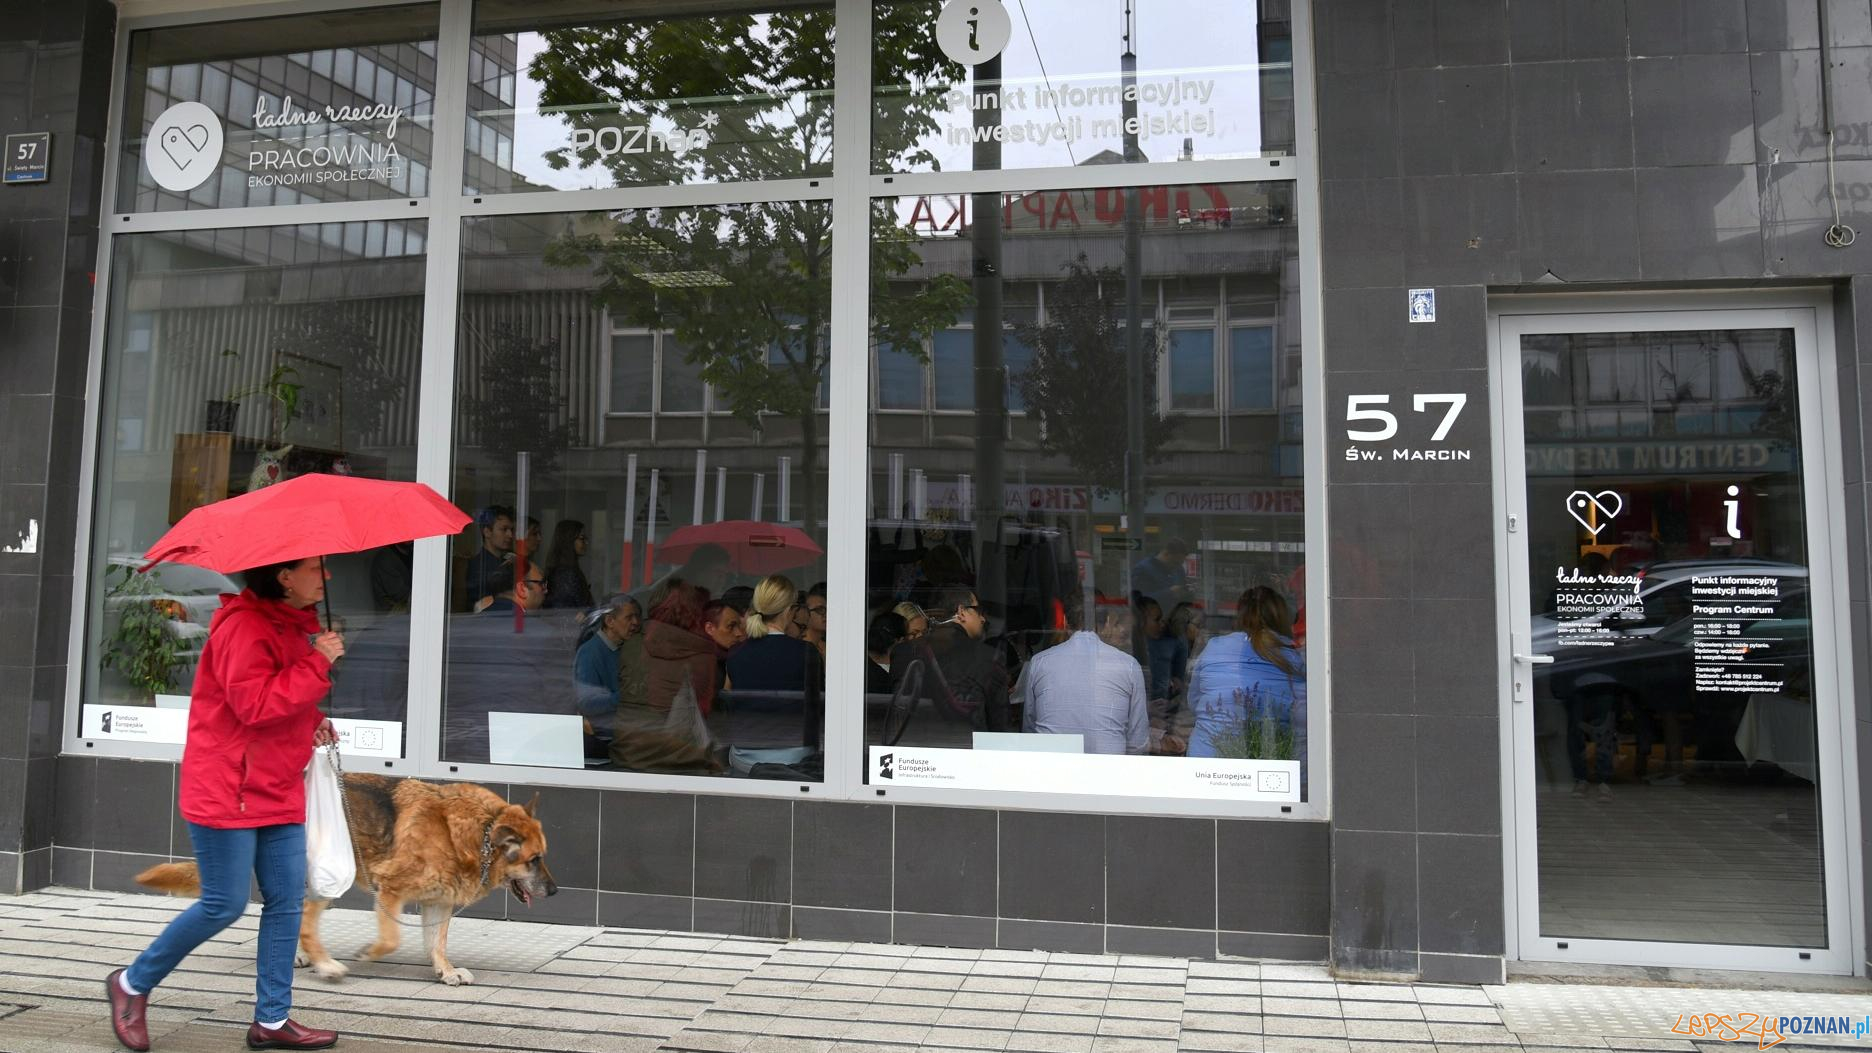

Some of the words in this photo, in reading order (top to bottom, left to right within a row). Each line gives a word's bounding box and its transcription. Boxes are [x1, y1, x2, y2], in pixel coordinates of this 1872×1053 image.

[948, 85, 1026, 114] Punkt
[1035, 77, 1214, 112] informacyjny
[252, 96, 321, 129] ładne
[325, 102, 403, 139] rzeczy
[948, 114, 1084, 147] inwestycji
[1092, 109, 1216, 140] miejskiej
[17, 143, 37, 160] 57
[248, 142, 400, 171] PRACOWNIA
[248, 173, 313, 189] EKONOMII
[316, 167, 400, 184] SPOŁECZNEJ
[1556, 566, 1596, 584] ładne
[1598, 574, 1643, 594] rzeczy
[1692, 577, 1718, 585] Punkt
[1720, 577, 1777, 587] informacyjny
[1556, 594, 1643, 605] PRACOWNIA
[1692, 586, 1736, 596] inwestycji
[1739, 587, 1778, 597] miejskiej
[1693, 605, 1732, 615] Program
[1734, 606, 1774, 614] Centrum
[898, 757, 929, 765] Fundusze
[1195, 771, 1211, 779] Unia
[1212, 772, 1252, 781] Europejska
